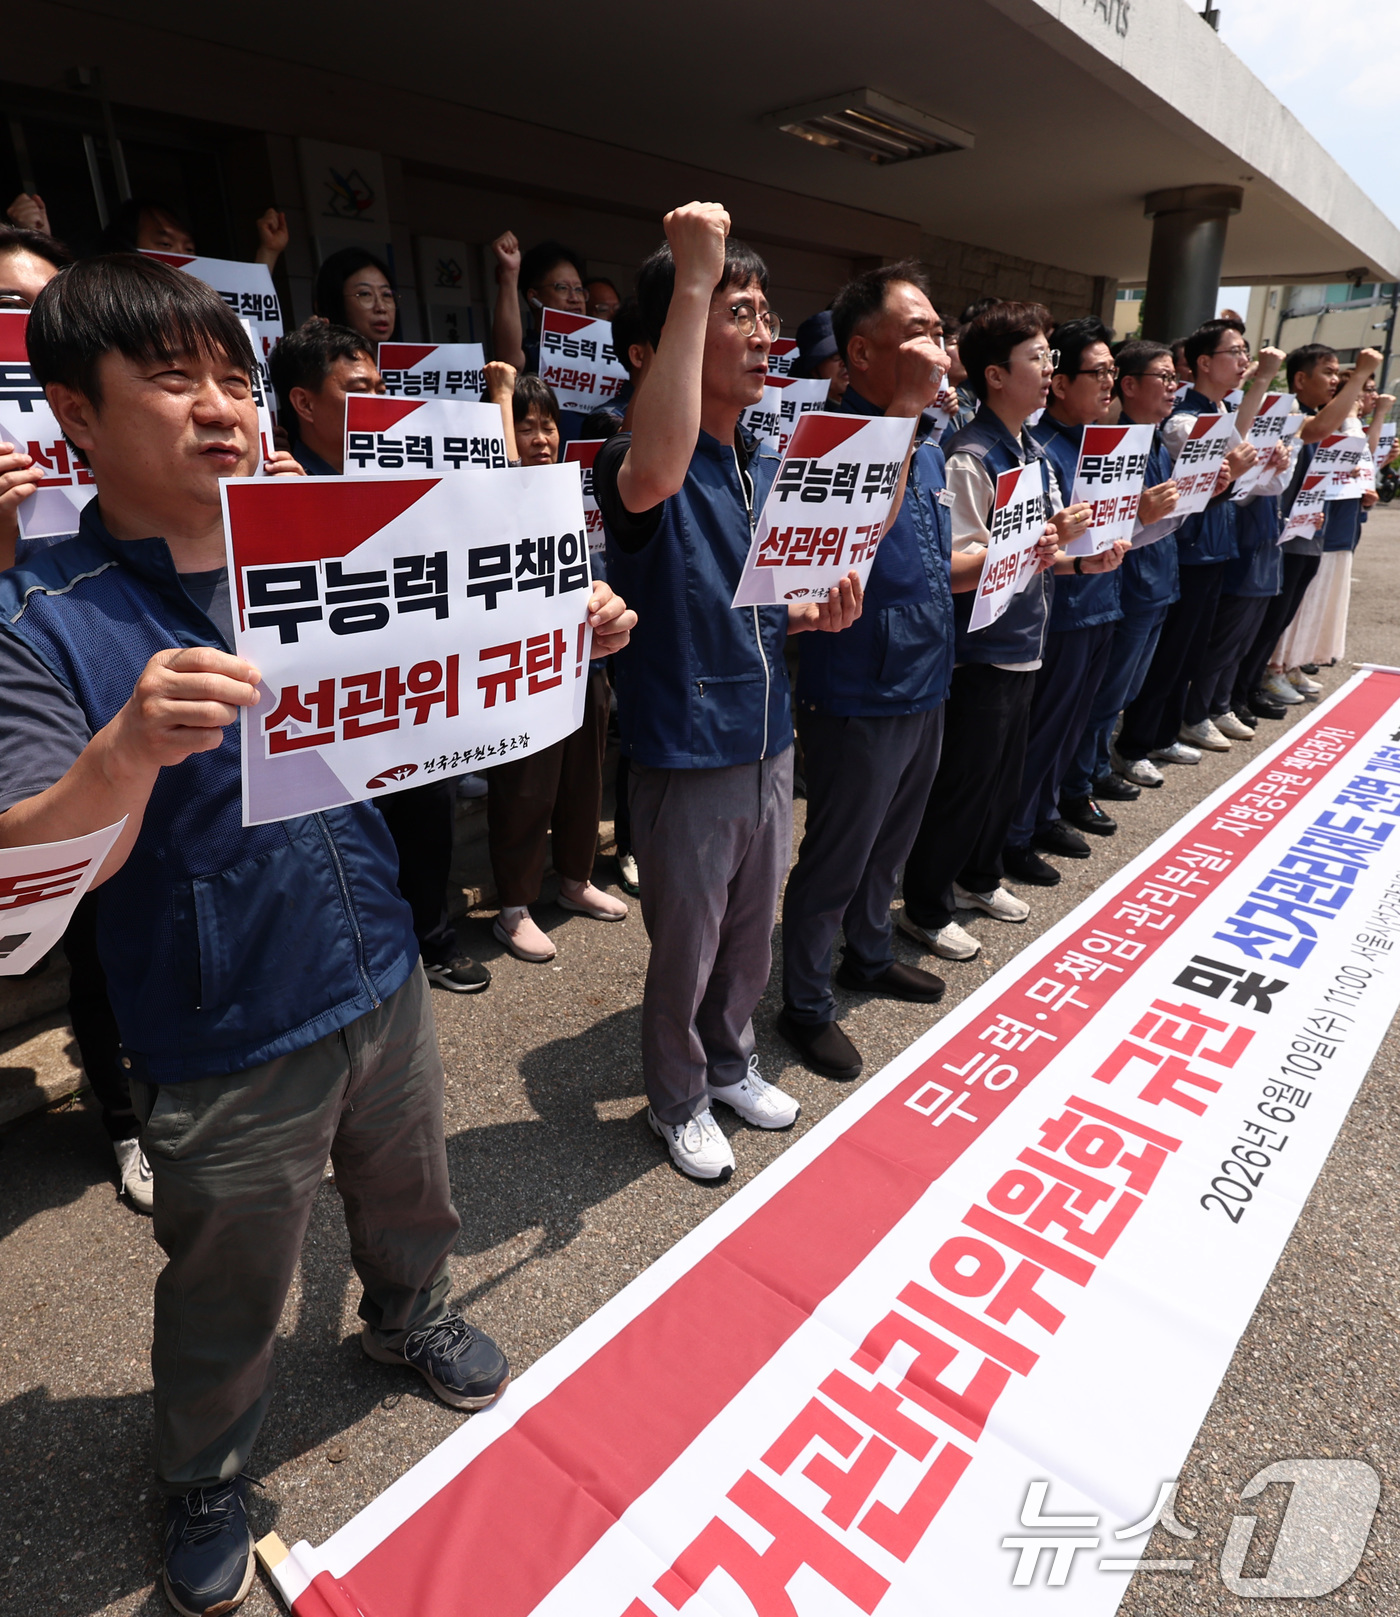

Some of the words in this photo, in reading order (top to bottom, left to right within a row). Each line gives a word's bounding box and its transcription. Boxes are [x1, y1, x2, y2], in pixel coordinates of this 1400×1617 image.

[543, 331, 598, 362] 무능력
[767, 356, 796, 374] 무능
[381, 369, 441, 396] 무능력
[543, 365, 597, 394] 선관위
[348, 433, 434, 469] 무능력
[443, 437, 506, 470] 무책임
[1079, 455, 1126, 485] 무능력
[1125, 453, 1148, 481] 무책
[774, 460, 861, 504] 무능력
[861, 461, 903, 503] 무책
[991, 501, 1024, 545] 무능력
[1026, 494, 1046, 530] 무책
[755, 525, 849, 568] 선관위
[246, 550, 450, 645] 무능력
[466, 529, 590, 611] 무책임
[981, 551, 1021, 597] 선관위
[264, 654, 460, 755] 선관위
[423, 732, 530, 774] 전국공무원노동조합
[1210, 769, 1314, 838] 지방공무원
[1280, 725, 1357, 771] 책임전가!
[1211, 809, 1397, 970] 선거관리제도
[1171, 954, 1290, 1015] 및
[1090, 997, 1257, 1118] 규탄
[1279, 1007, 1356, 1081] 10일(수)
[1256, 1077, 1312, 1125] 6월
[1200, 1119, 1290, 1225] 2026년
[620, 1094, 1183, 1617] 거관리위원회
